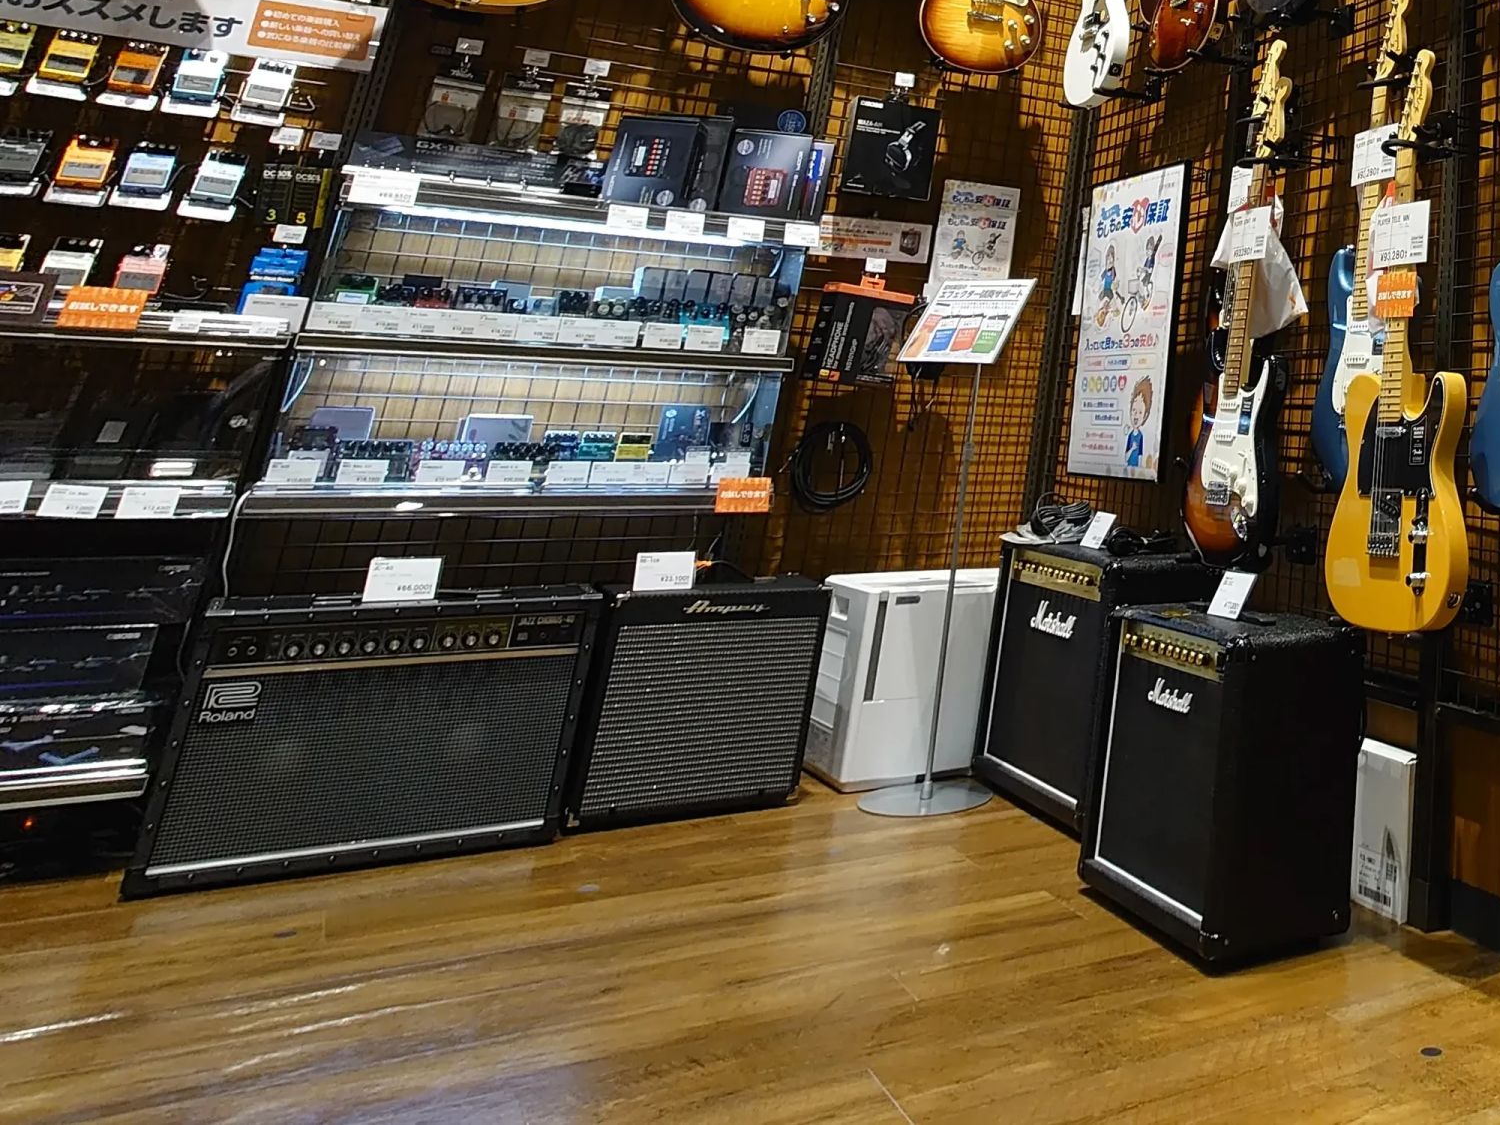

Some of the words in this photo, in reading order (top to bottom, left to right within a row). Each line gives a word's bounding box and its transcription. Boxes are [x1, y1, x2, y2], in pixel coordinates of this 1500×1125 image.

[1030, 599, 1078, 640] Marshall
[1147, 677, 1194, 714] Marshall
[198, 709, 256, 724] Roland
